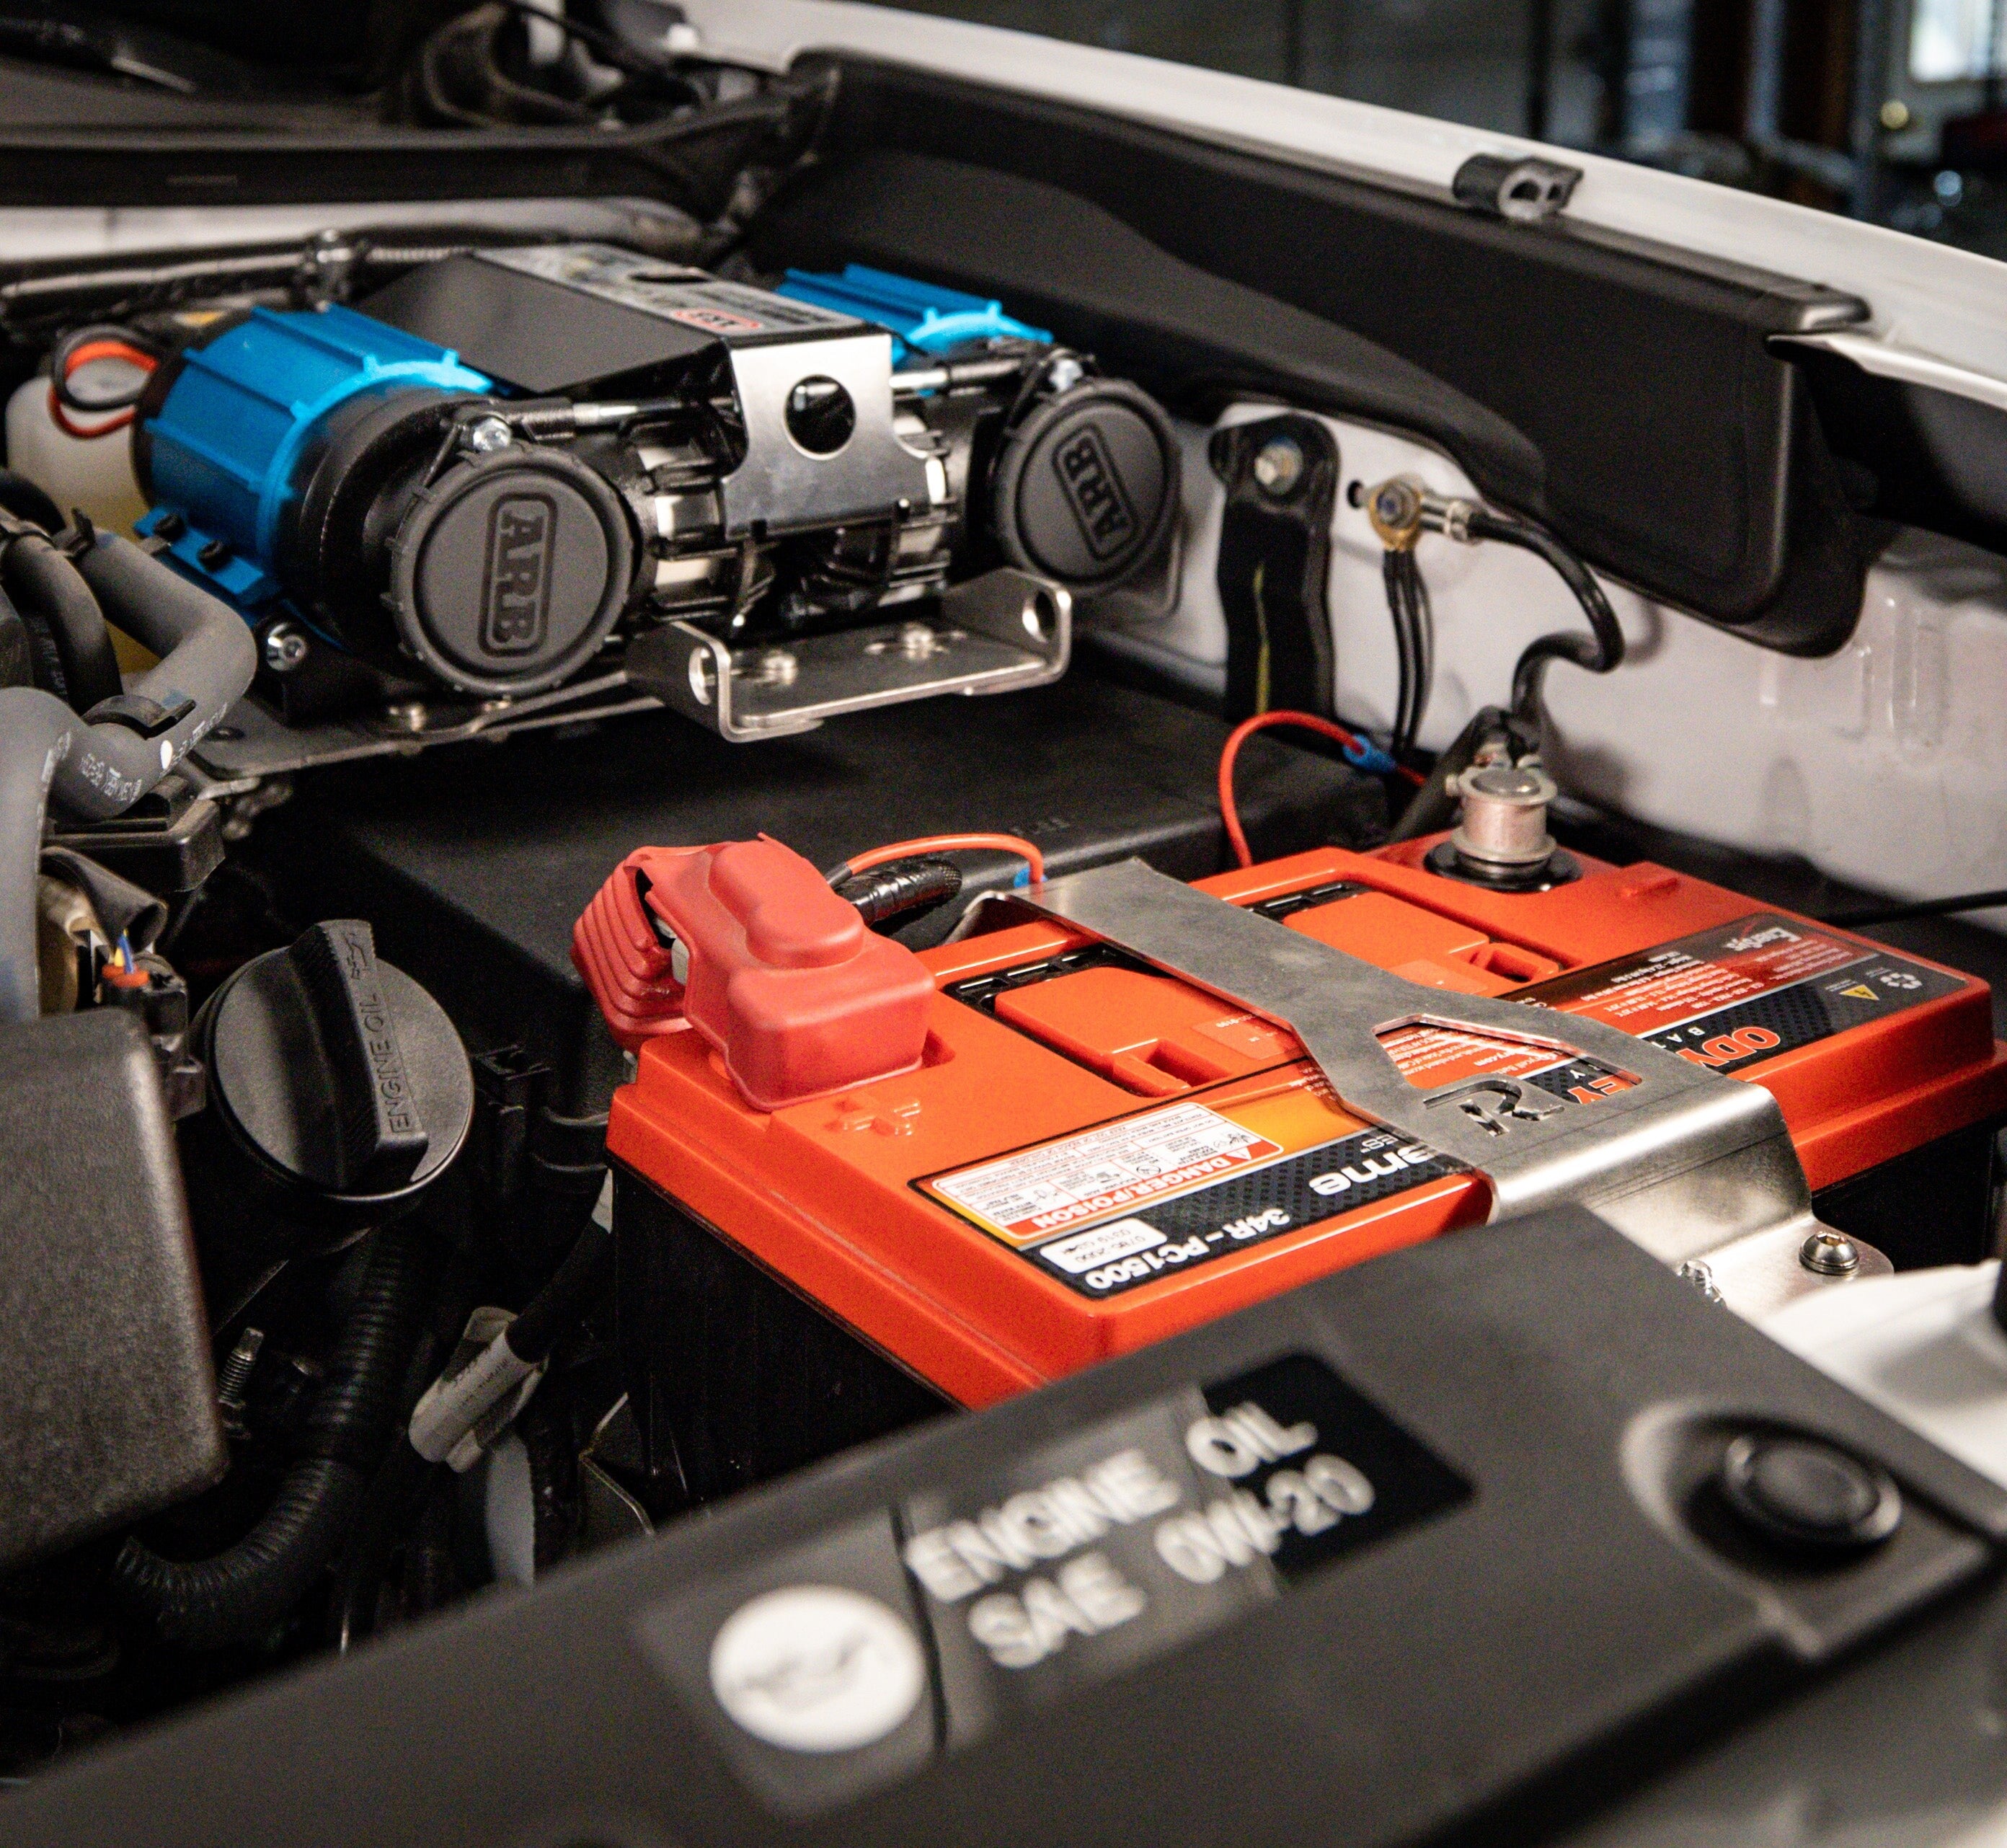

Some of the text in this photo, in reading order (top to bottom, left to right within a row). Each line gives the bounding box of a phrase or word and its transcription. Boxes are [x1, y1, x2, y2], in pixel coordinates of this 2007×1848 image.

[1064, 436, 1133, 539] ARB
[492, 510, 541, 643] ARB
[359, 992, 413, 1134] ENGINE OIL
[1029, 1156, 1233, 1229] DANGER/POISON
[906, 1400, 1319, 1603] ENGINE OIL
[967, 1550, 1148, 1669] SAE
